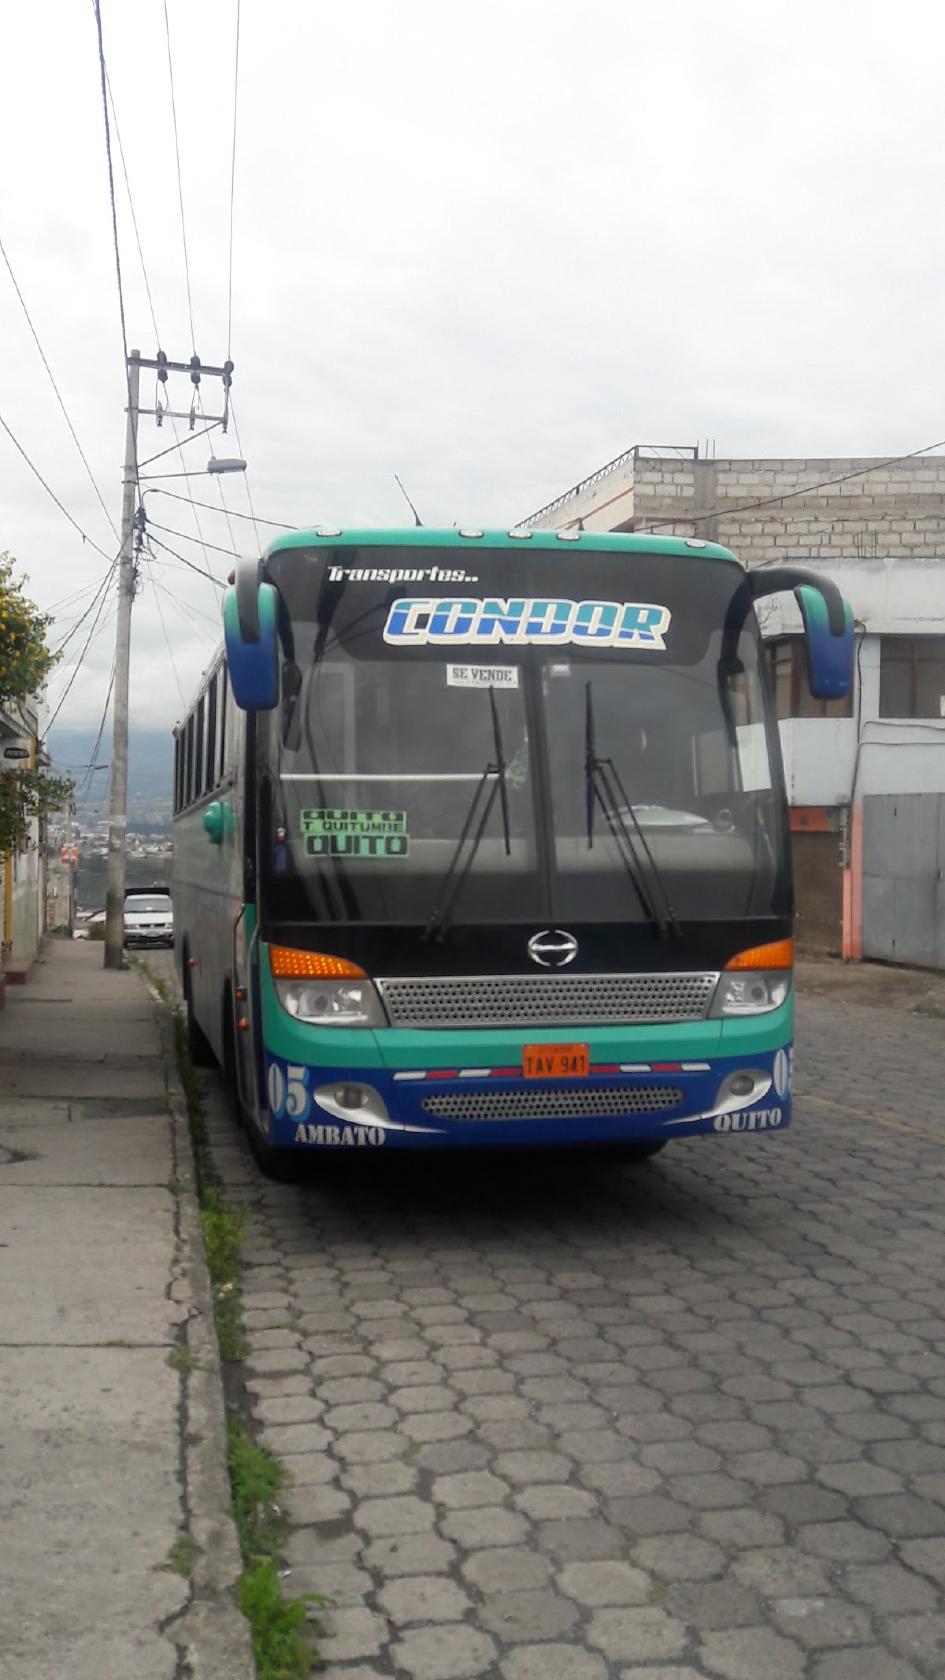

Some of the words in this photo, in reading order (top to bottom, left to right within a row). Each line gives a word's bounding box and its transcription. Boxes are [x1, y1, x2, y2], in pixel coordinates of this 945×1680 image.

[384, 598, 671, 650] CONDOR
[452, 667, 469, 680] SE
[471, 668, 512, 681] VENDE
[307, 835, 408, 855] QUITO
[526, 1055, 554, 1075] TAV
[560, 1055, 585, 1074] 941
[268, 1062, 309, 1119] 05
[714, 1107, 782, 1132] QUITO
[294, 1123, 386, 1146] AMBATO
